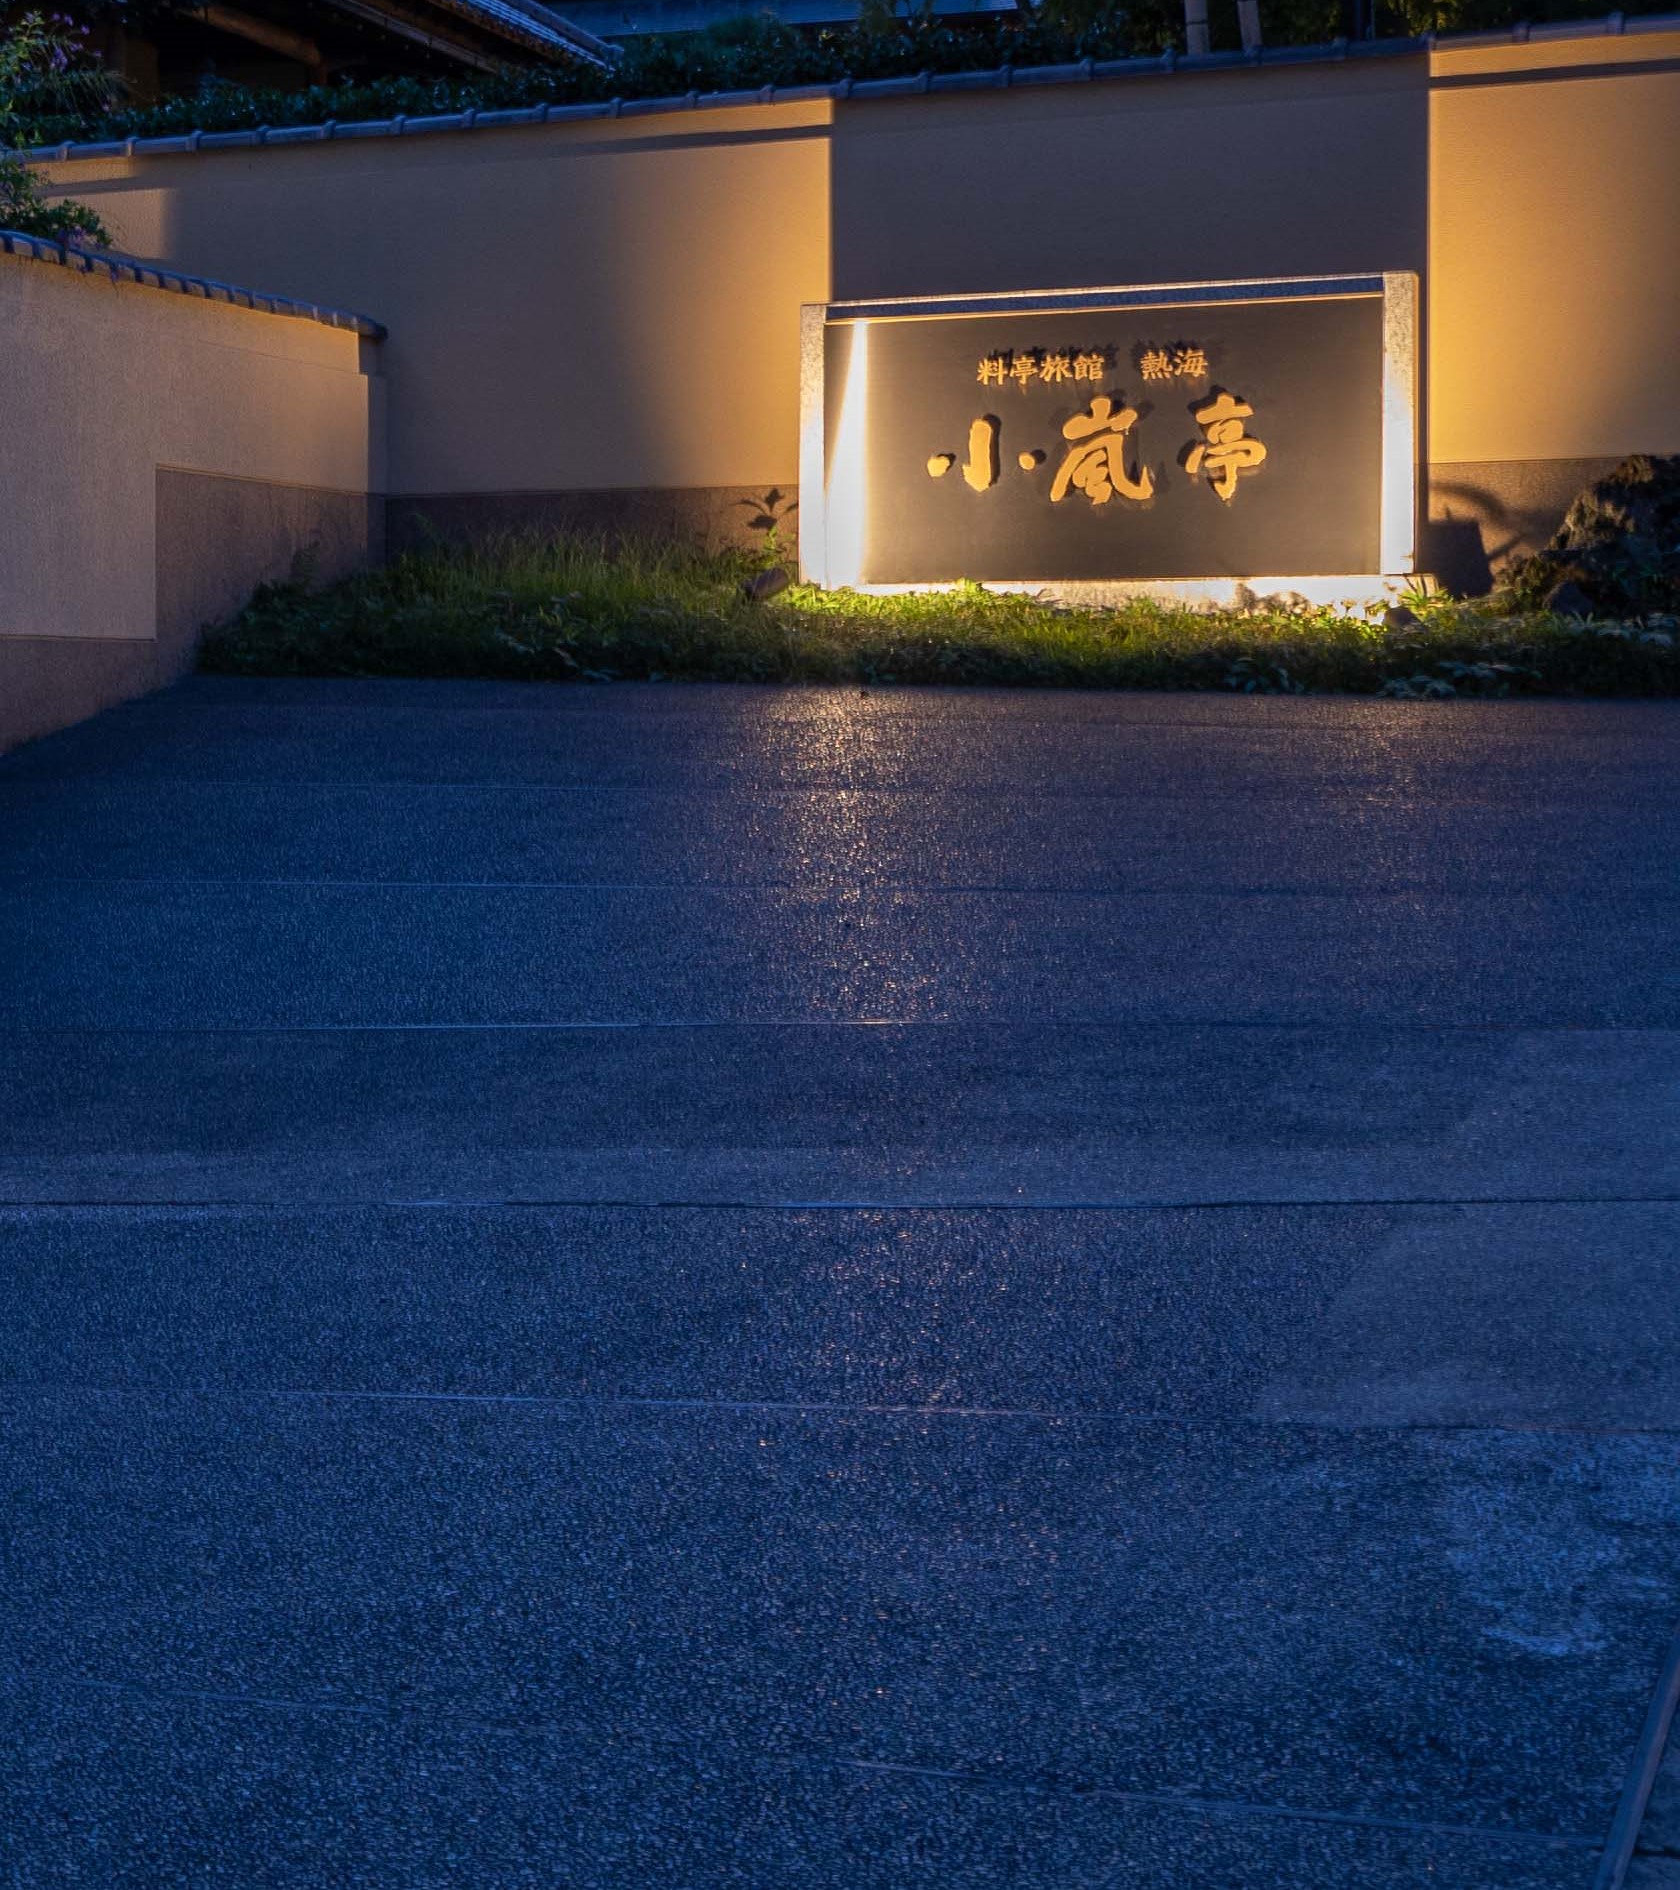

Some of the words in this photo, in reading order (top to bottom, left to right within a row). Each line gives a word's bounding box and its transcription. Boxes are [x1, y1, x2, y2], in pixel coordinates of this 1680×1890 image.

[977, 357, 1104, 385] 料亭旅館
[1140, 350, 1208, 380] 熱海
[926, 395, 1268, 505] 小嵐亭
